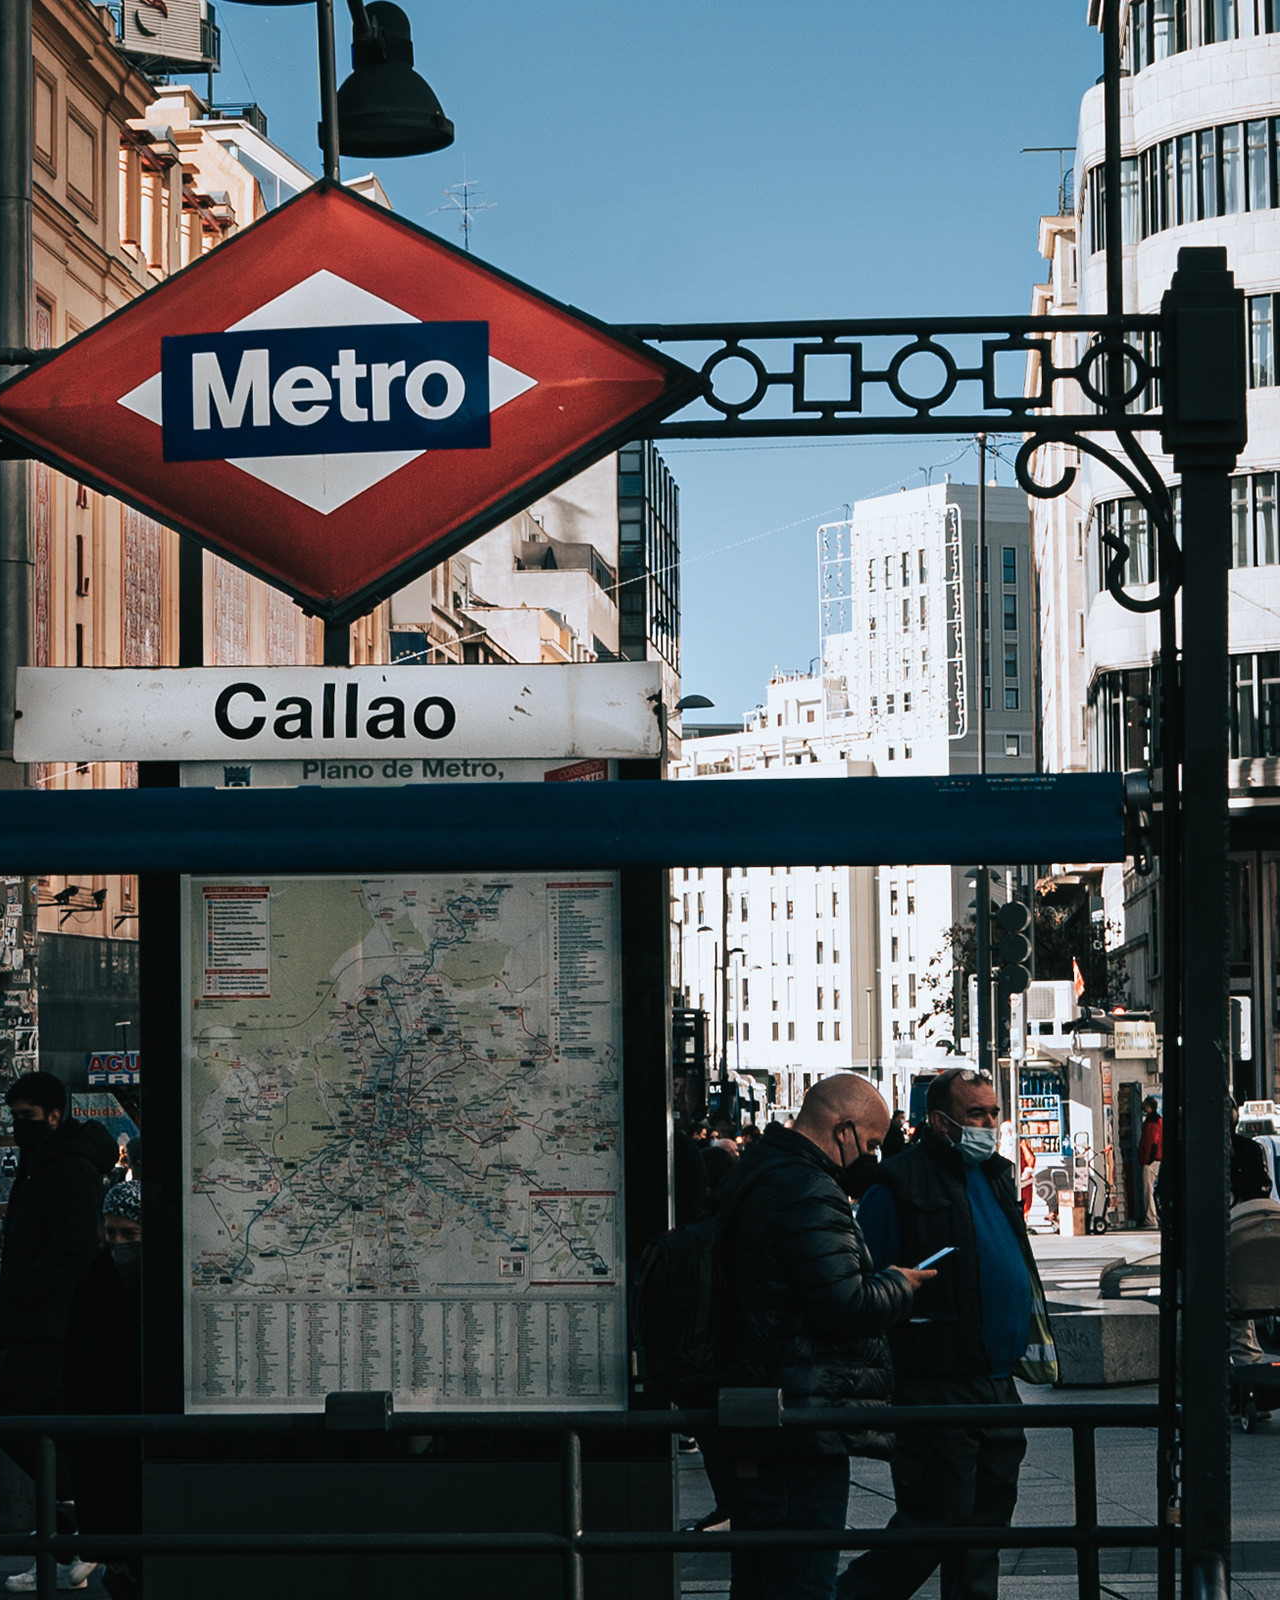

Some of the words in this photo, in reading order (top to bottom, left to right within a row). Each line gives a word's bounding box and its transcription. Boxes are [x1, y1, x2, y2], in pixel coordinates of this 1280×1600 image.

[191, 347, 466, 431] Metro
[214, 682, 456, 741] Callao
[302, 761, 374, 780] Plano
[381, 760, 414, 780] de
[422, 759, 505, 780] Metro,
[73, 1106, 123, 1118] Bebidas
